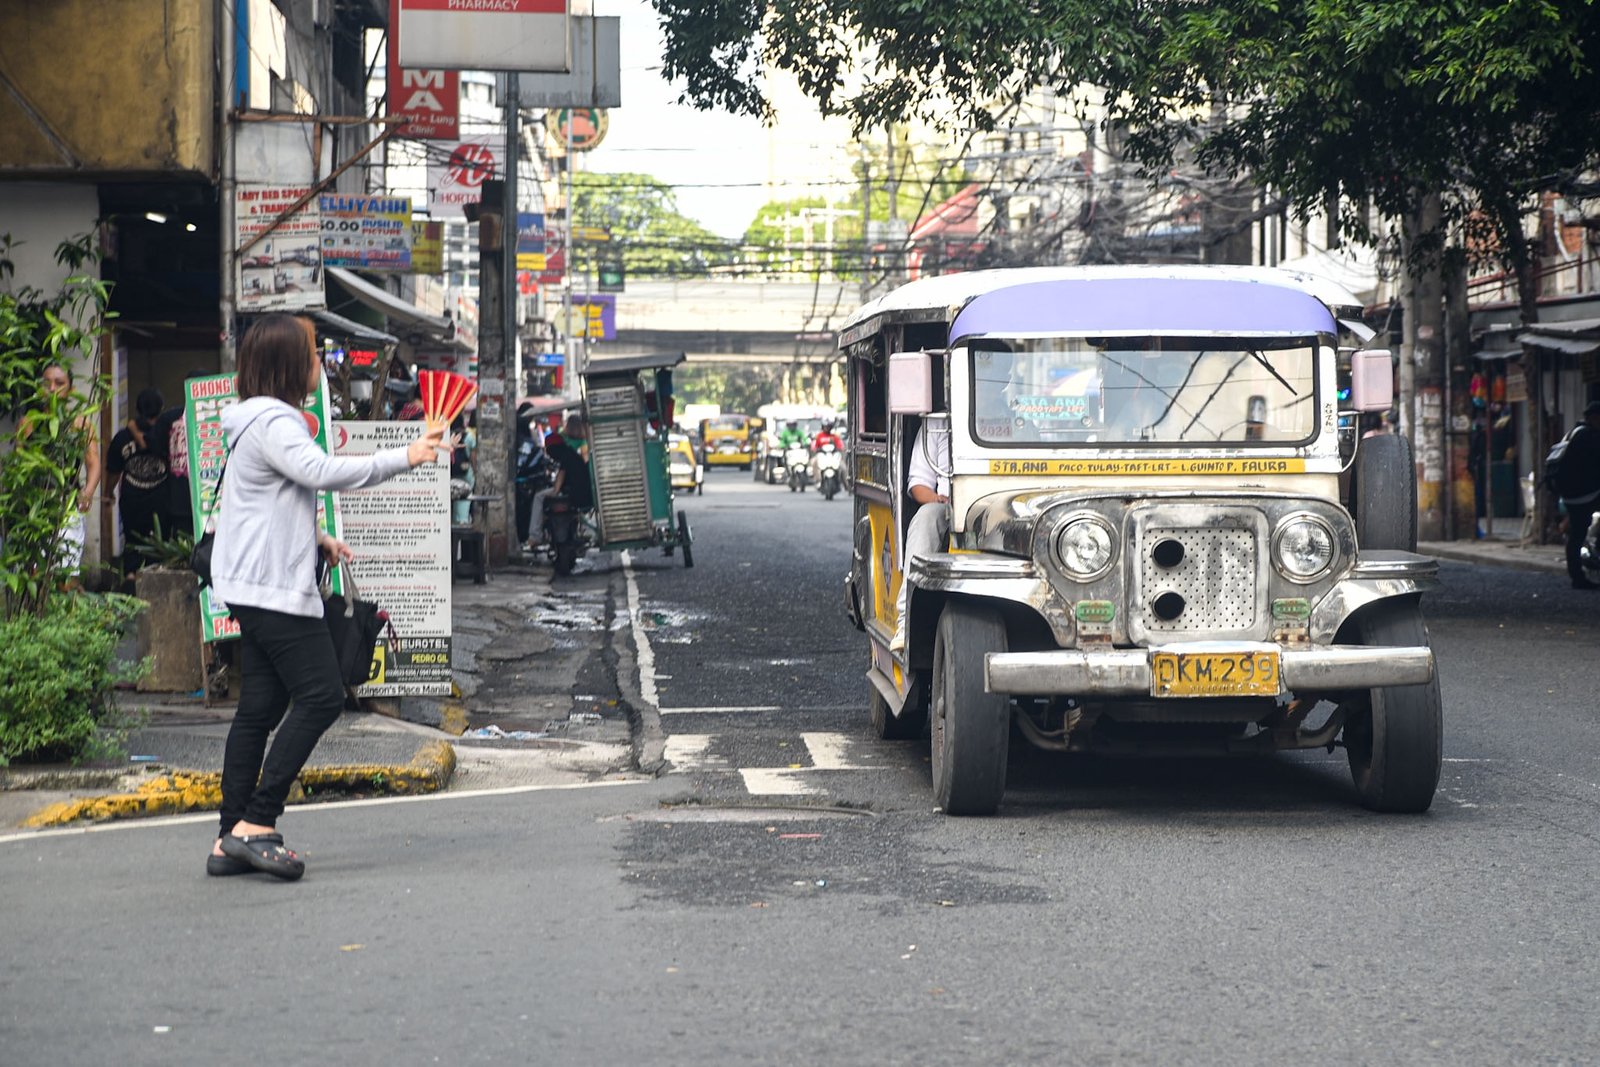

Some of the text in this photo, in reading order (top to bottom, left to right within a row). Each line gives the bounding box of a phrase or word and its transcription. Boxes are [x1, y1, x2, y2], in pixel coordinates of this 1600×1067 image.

[448, 0, 519, 10] PHARMACY
[429, 114, 455, 126] Lung
[407, 125, 436, 135] Clinic
[980, 426, 1011, 437] 2024
[1242, 461, 1287, 473] FAURA
[401, 639, 449, 649] EUROTEL
[411, 653, 449, 664] PEDRO GIL
[398, 685, 421, 694] Place
[422, 684, 450, 694] Manila
